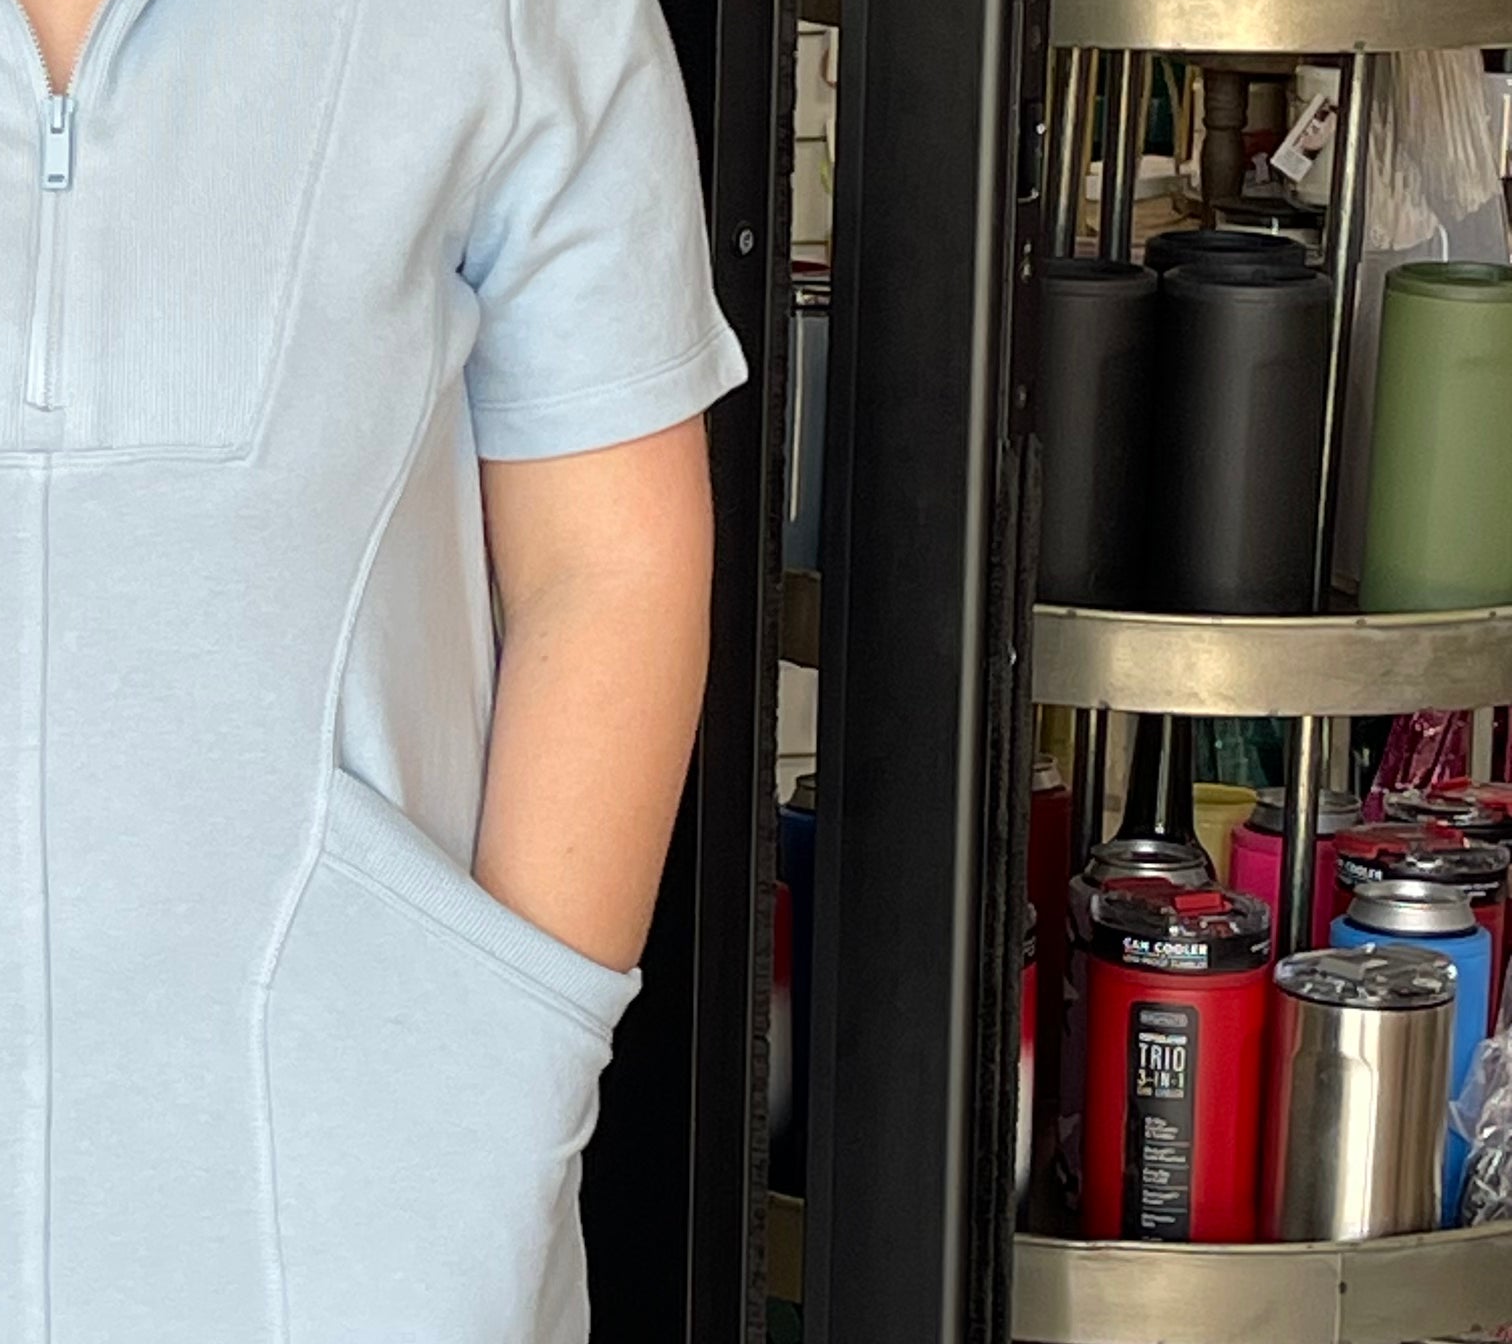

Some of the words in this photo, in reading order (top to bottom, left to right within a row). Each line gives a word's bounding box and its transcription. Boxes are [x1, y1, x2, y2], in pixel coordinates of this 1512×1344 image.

[1154, 941, 1208, 956] COOLER
[1138, 1042, 1187, 1072] TRIO
[1136, 1068, 1185, 1089] 3-IN-1
